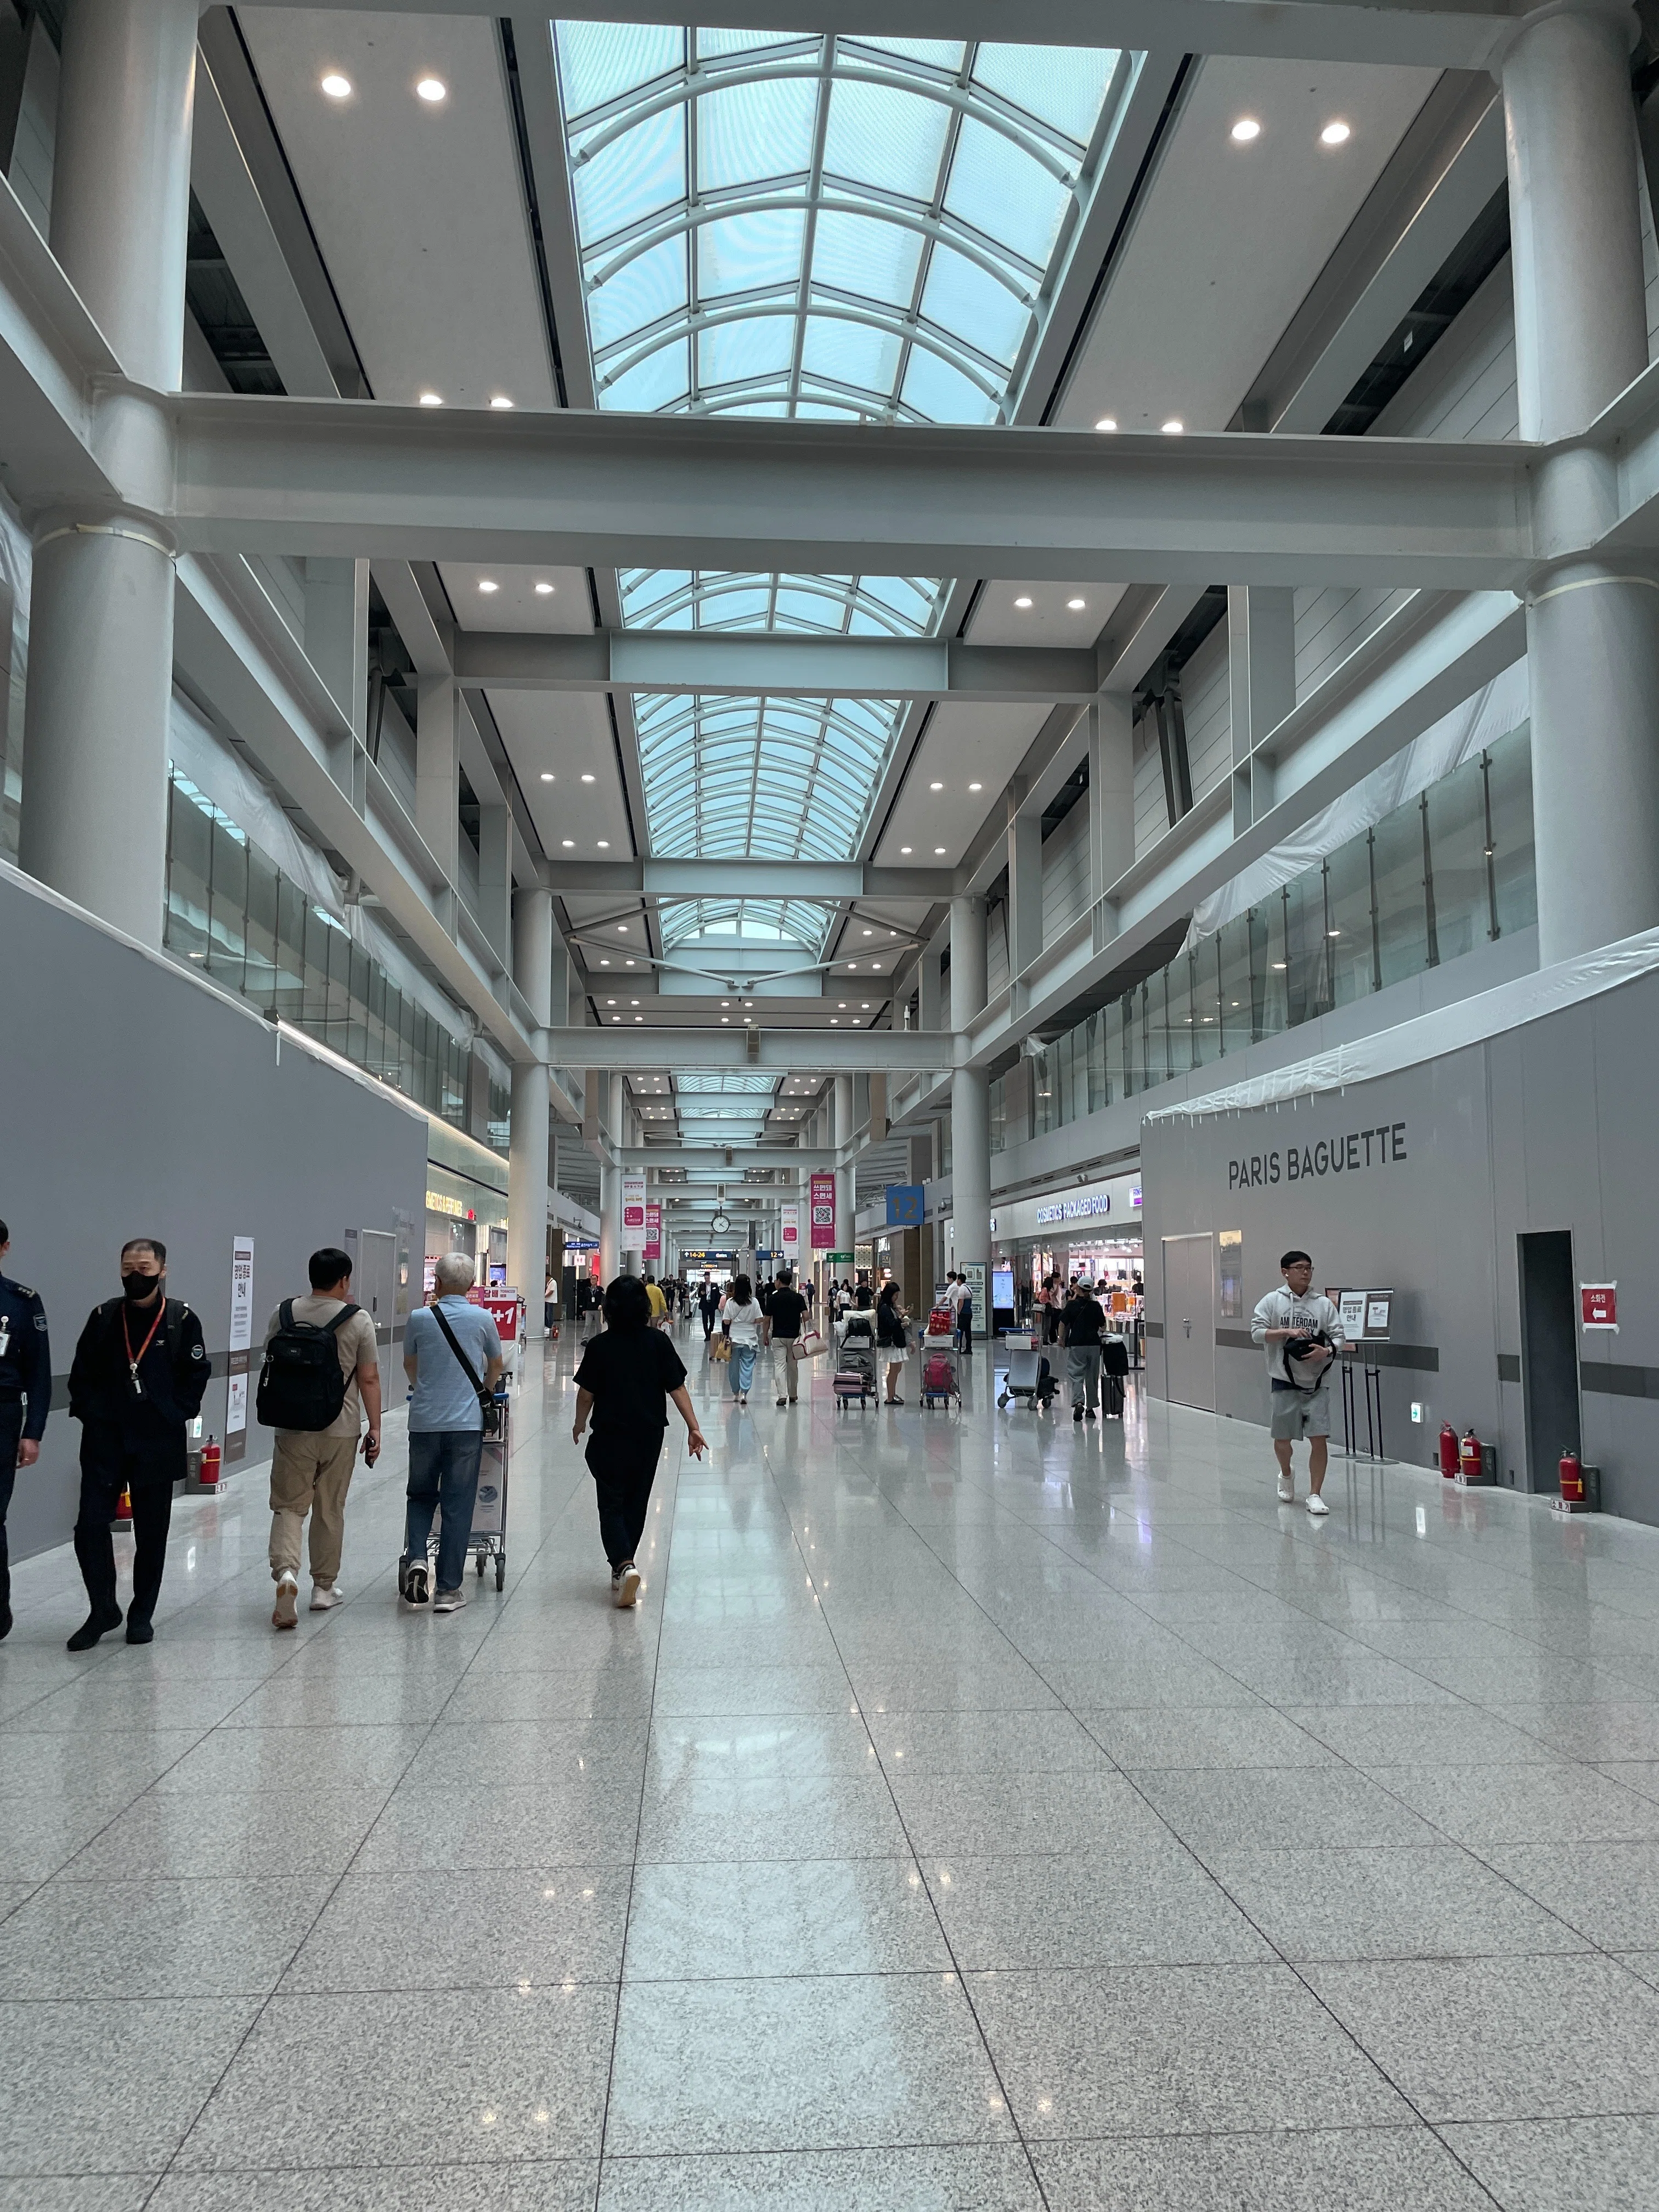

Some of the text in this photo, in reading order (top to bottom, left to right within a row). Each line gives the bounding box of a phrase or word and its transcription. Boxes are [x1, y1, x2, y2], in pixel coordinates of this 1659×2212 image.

[1229, 1122, 1407, 1190] PARIS BAGUETTE
[891, 1196, 918, 1219] 12
[1037, 1194, 1108, 1223] COSMETICS PACKAGED FOOD
[1590, 1294, 1606, 1304] 소화전
[1280, 1316, 1318, 1329] AMTERDAM
